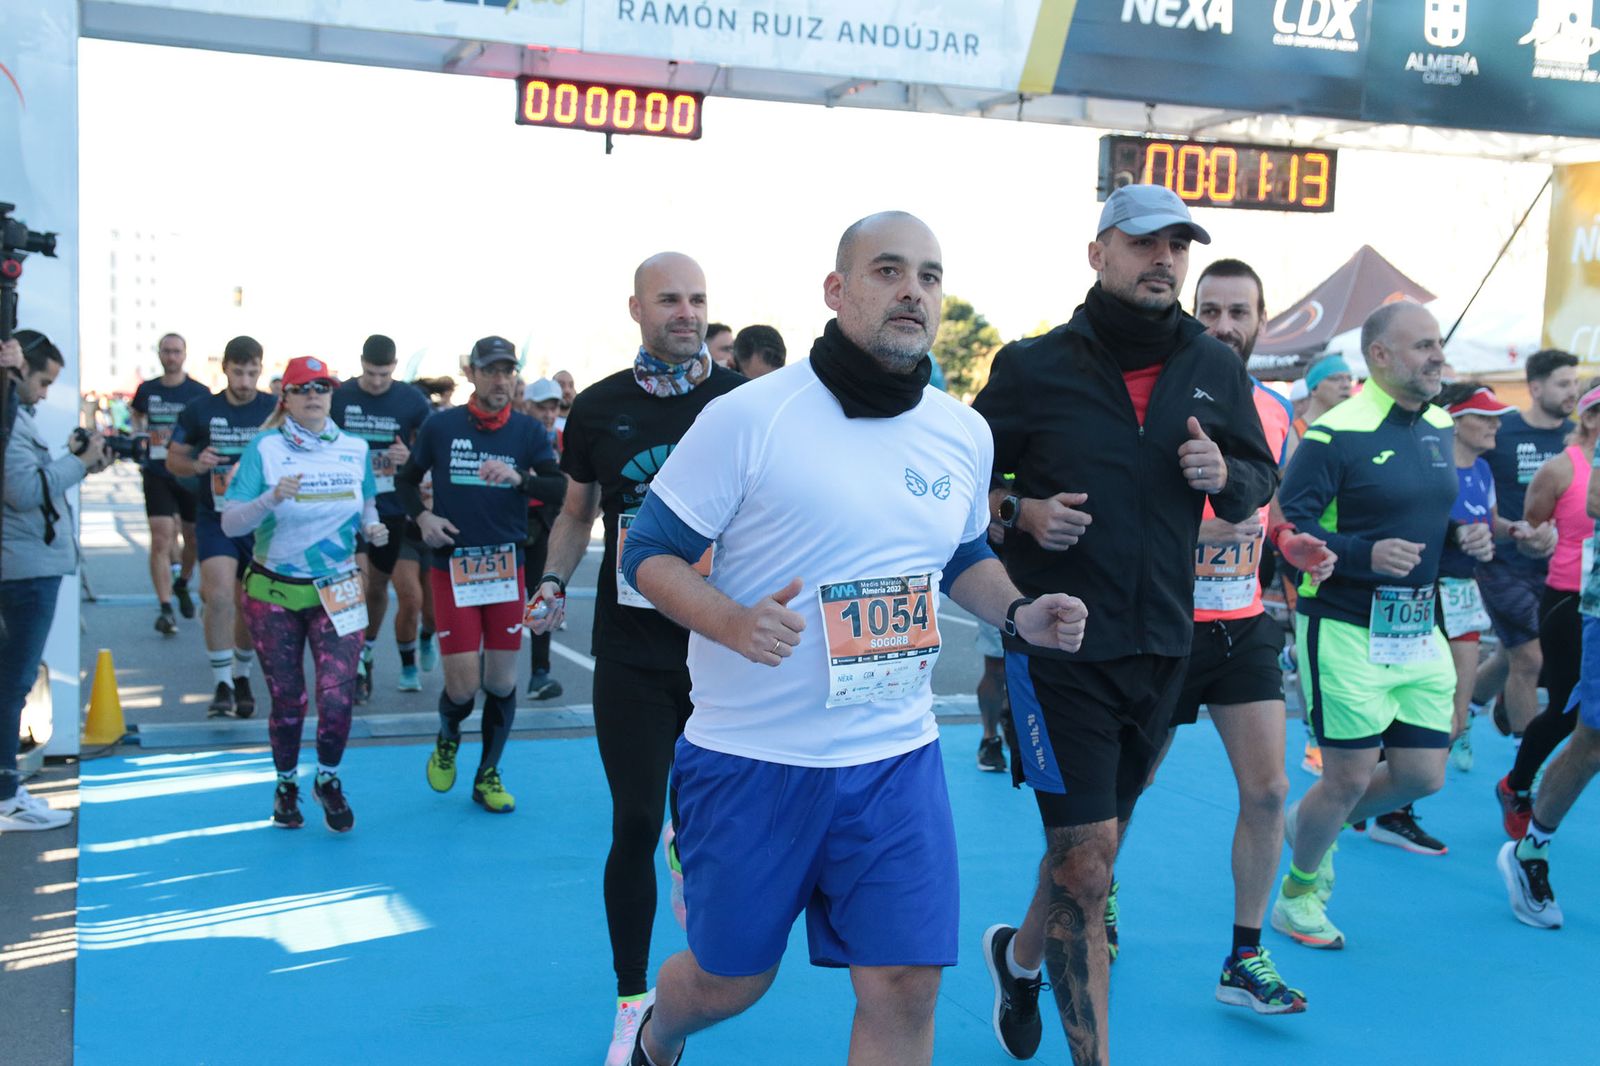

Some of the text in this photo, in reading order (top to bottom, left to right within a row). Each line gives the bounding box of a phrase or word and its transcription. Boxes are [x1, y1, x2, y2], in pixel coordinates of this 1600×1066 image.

[618, 0, 980, 56] RAMÓN RUIZ ANDÚJAR
[1273, 0, 1358, 40] CDX
[1405, 52, 1480, 76] ALMERÍA
[1195, 541, 1254, 564] 1211
[459, 554, 508, 575] 1751
[840, 594, 929, 638] 1054
[1384, 602, 1432, 624] 1056
[870, 635, 909, 649] SOGORB
